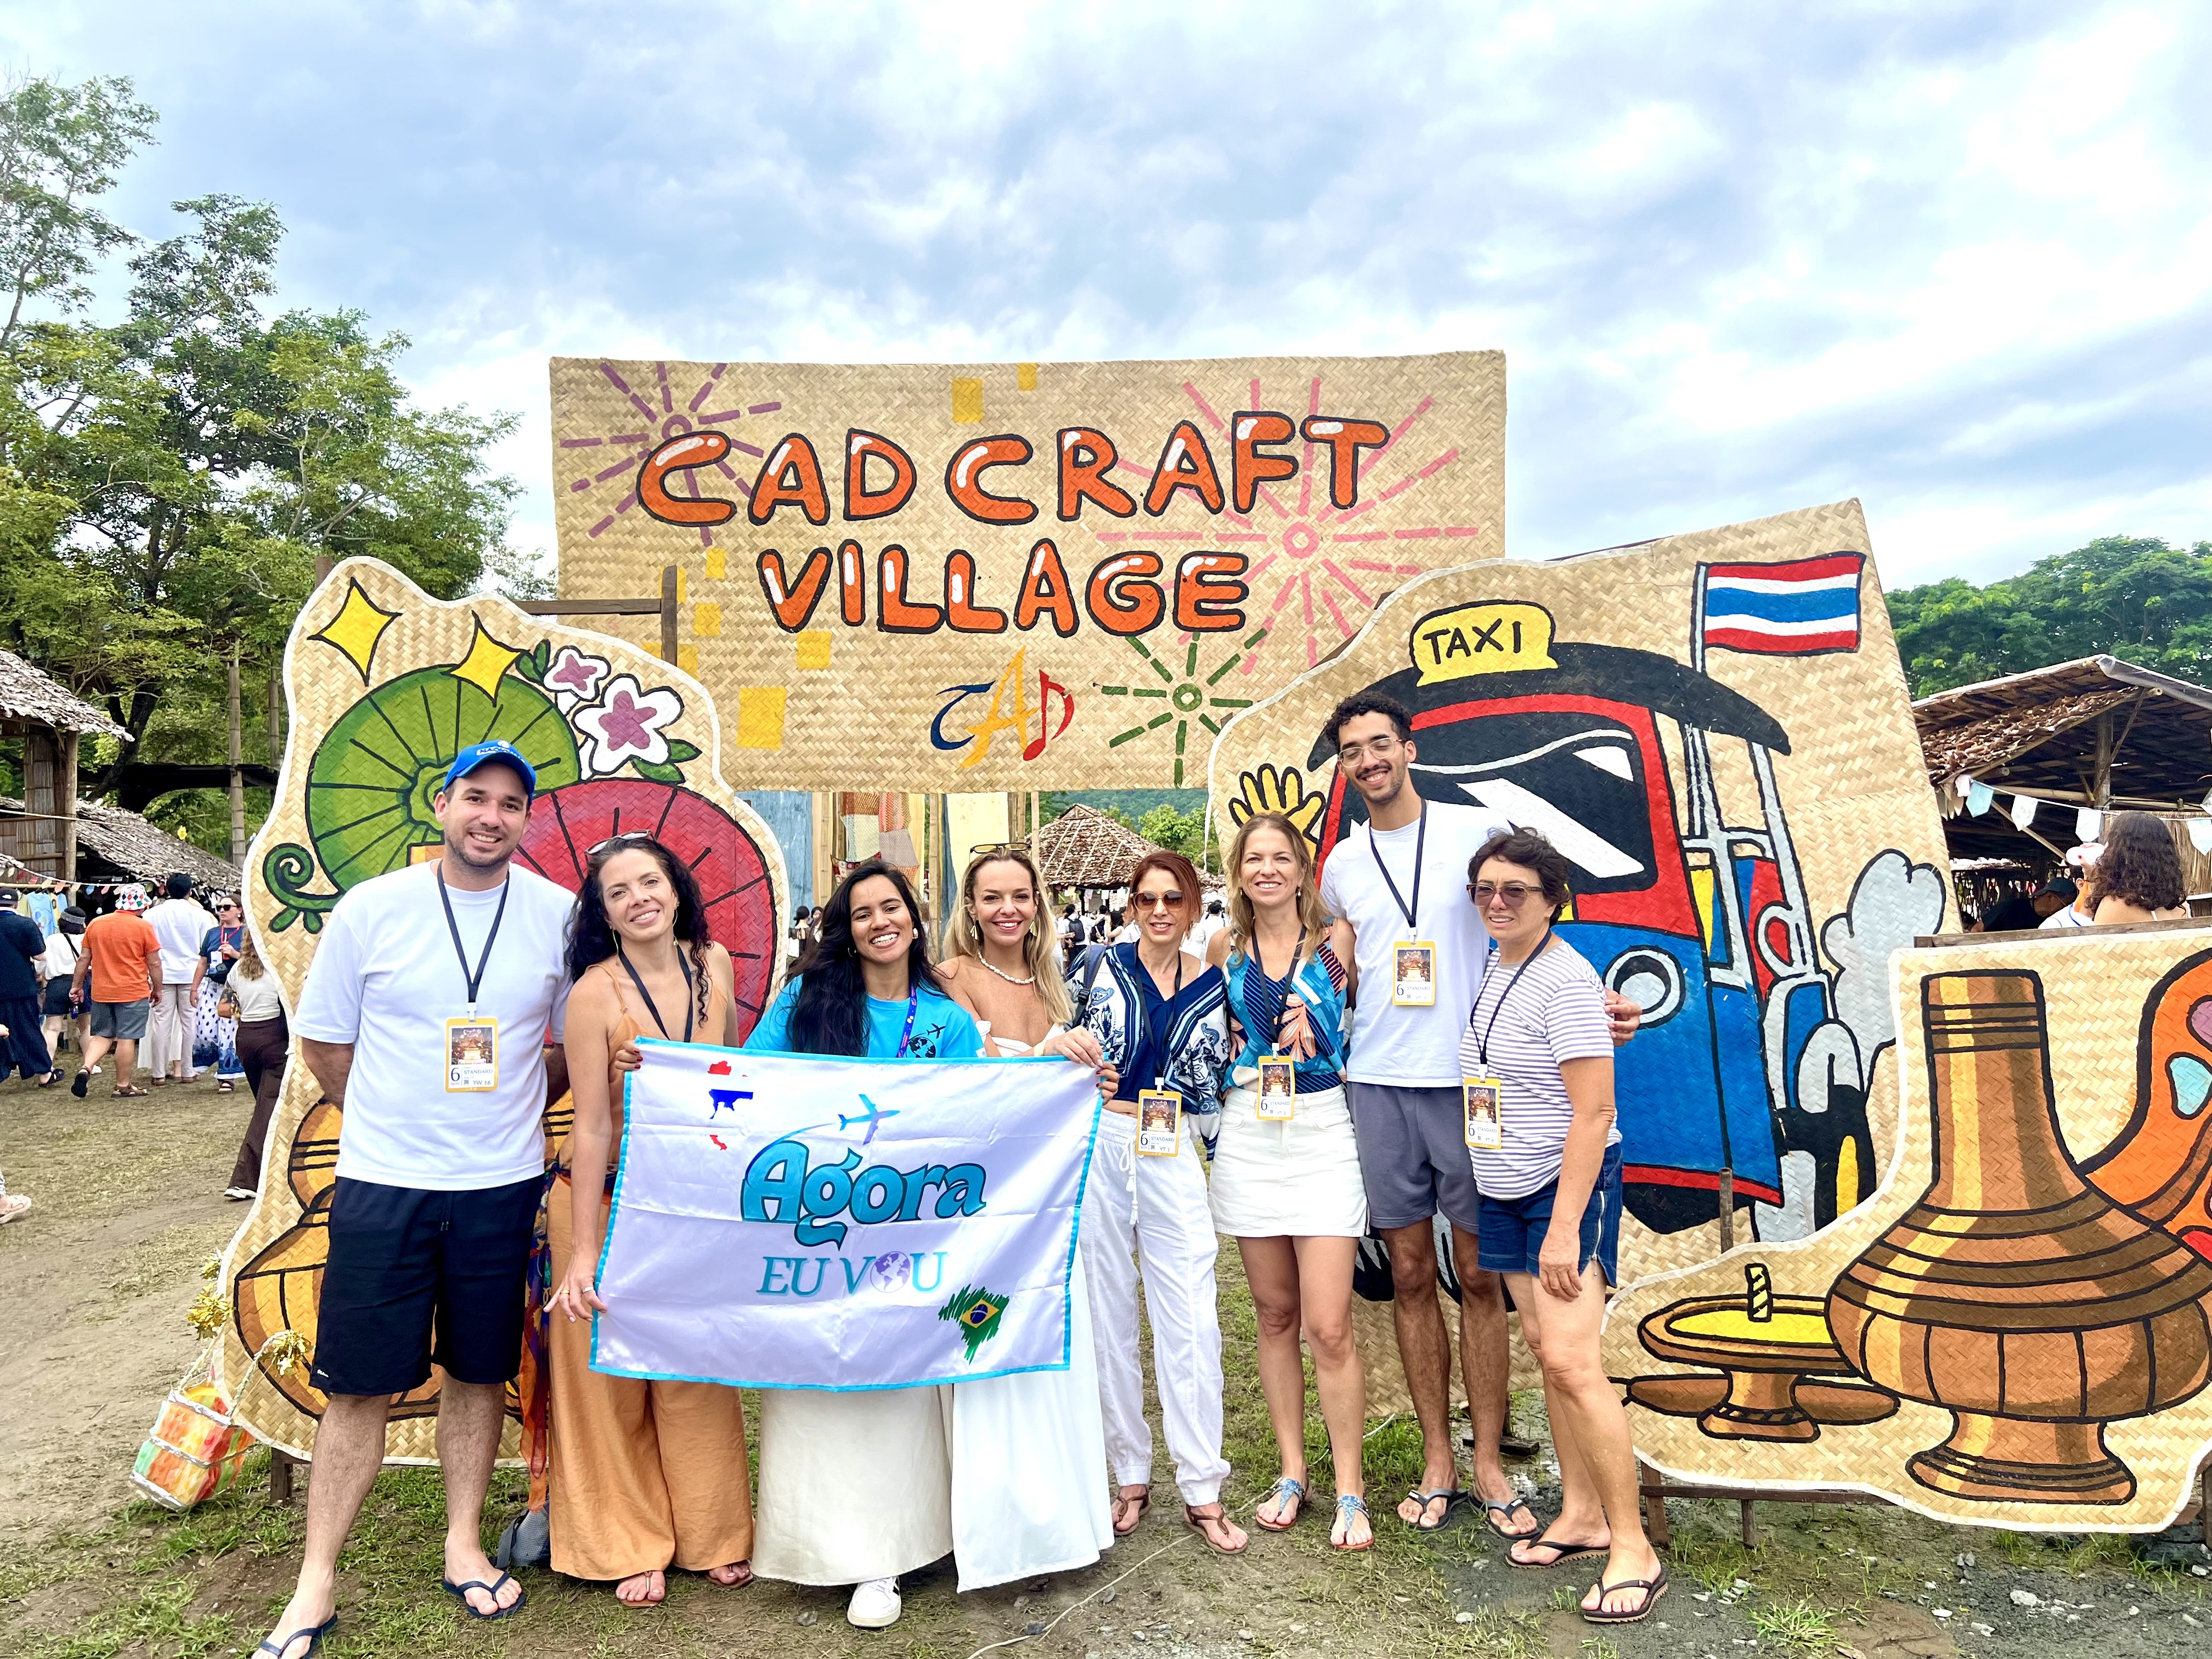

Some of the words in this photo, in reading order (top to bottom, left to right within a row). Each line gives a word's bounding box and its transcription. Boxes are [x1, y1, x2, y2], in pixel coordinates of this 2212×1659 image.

[636, 427, 917, 527] CAD
[945, 410, 1390, 525] CRAFT
[757, 538, 1250, 637] VILLAGE
[1423, 618, 1523, 665] TAXI
[1397, 984, 1404, 996] 6
[450, 1068, 460, 1082] 6
[1261, 1098, 1268, 1111] 6
[1140, 1133, 1148, 1146] 6
[1469, 1123, 1475, 1137] 6
[741, 1140, 987, 1251] Agora
[755, 1256, 832, 1297] EU
